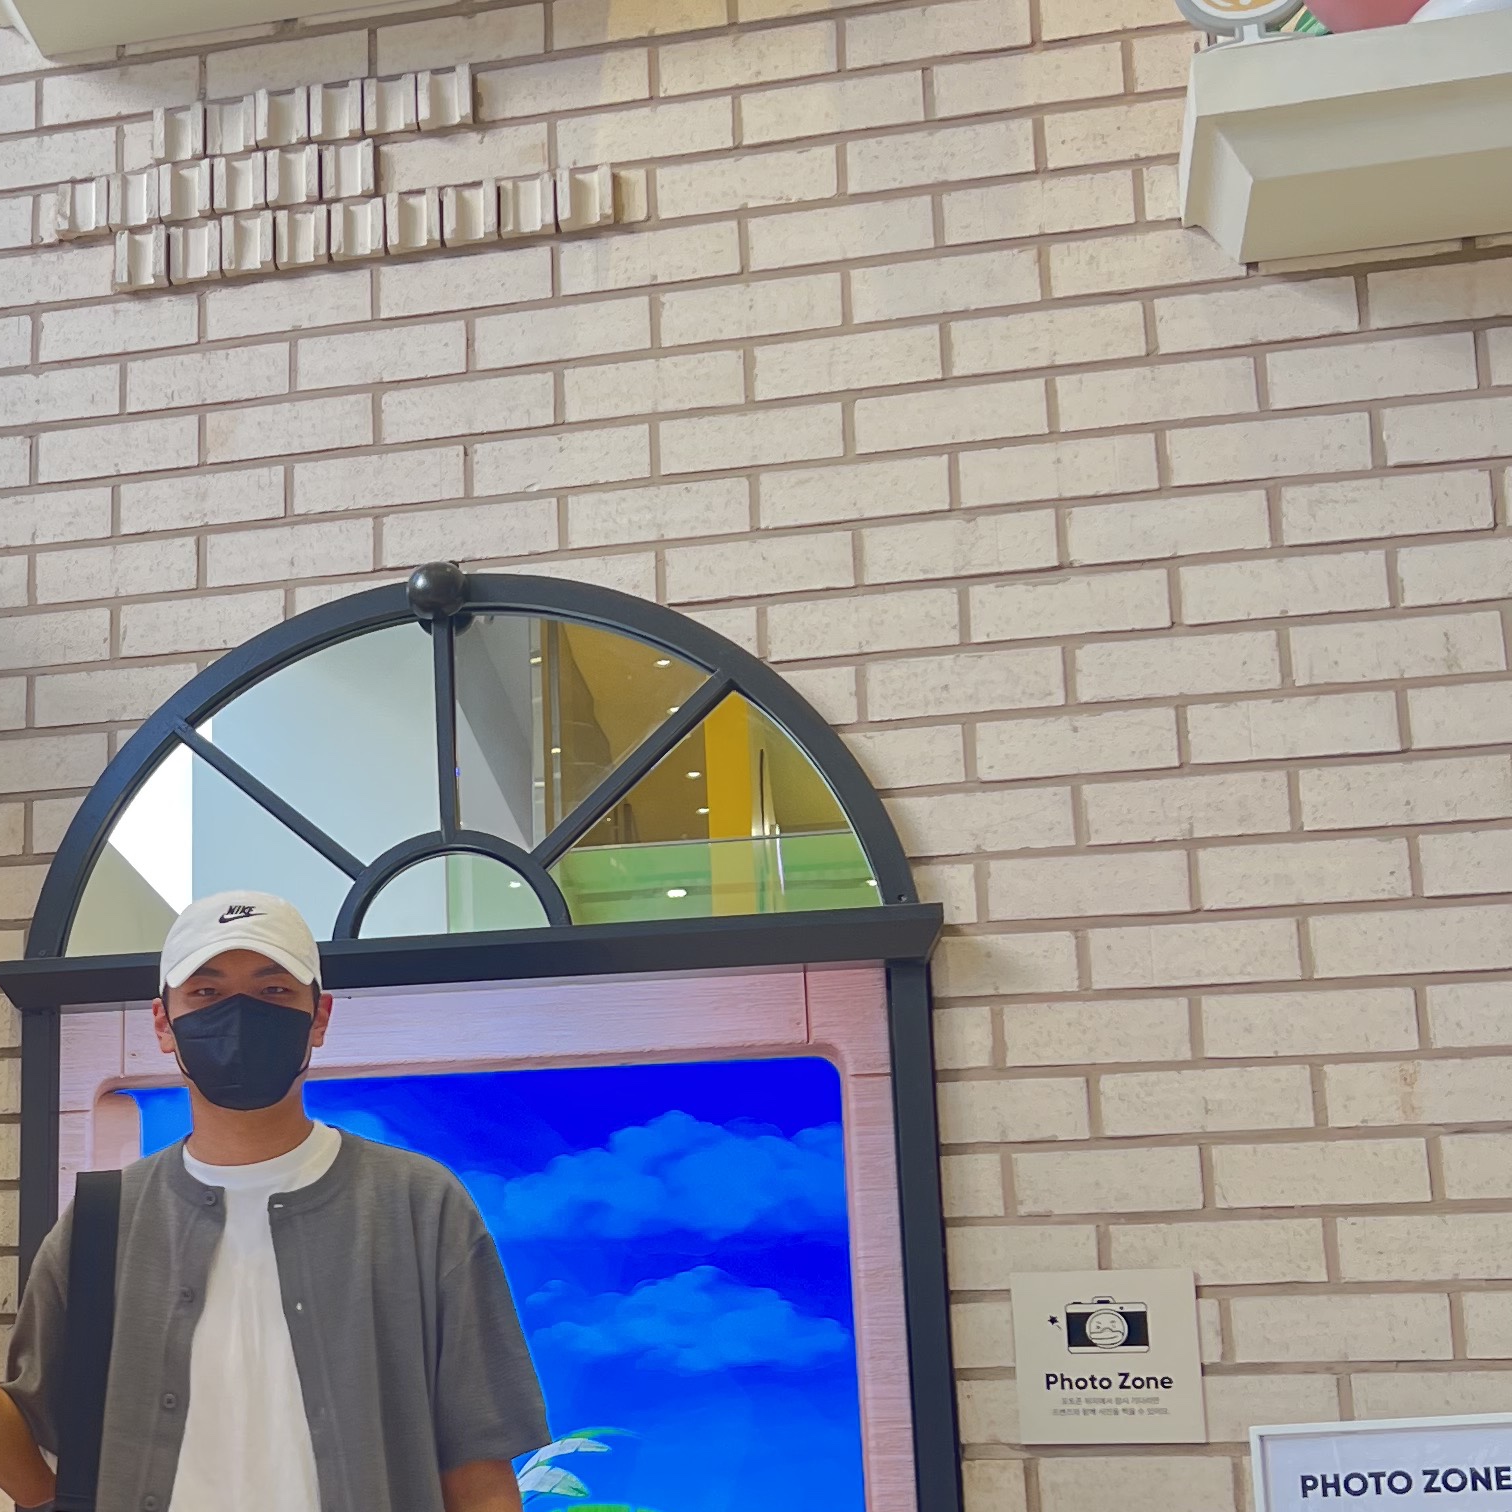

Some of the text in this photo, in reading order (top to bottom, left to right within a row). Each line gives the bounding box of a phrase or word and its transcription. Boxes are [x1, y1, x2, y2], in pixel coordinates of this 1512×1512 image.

[227, 905, 256, 916] NIKE
[1045, 1372, 1174, 1390] Photo Zone
[1300, 1466, 1512, 1498] PHOTO ZONE
